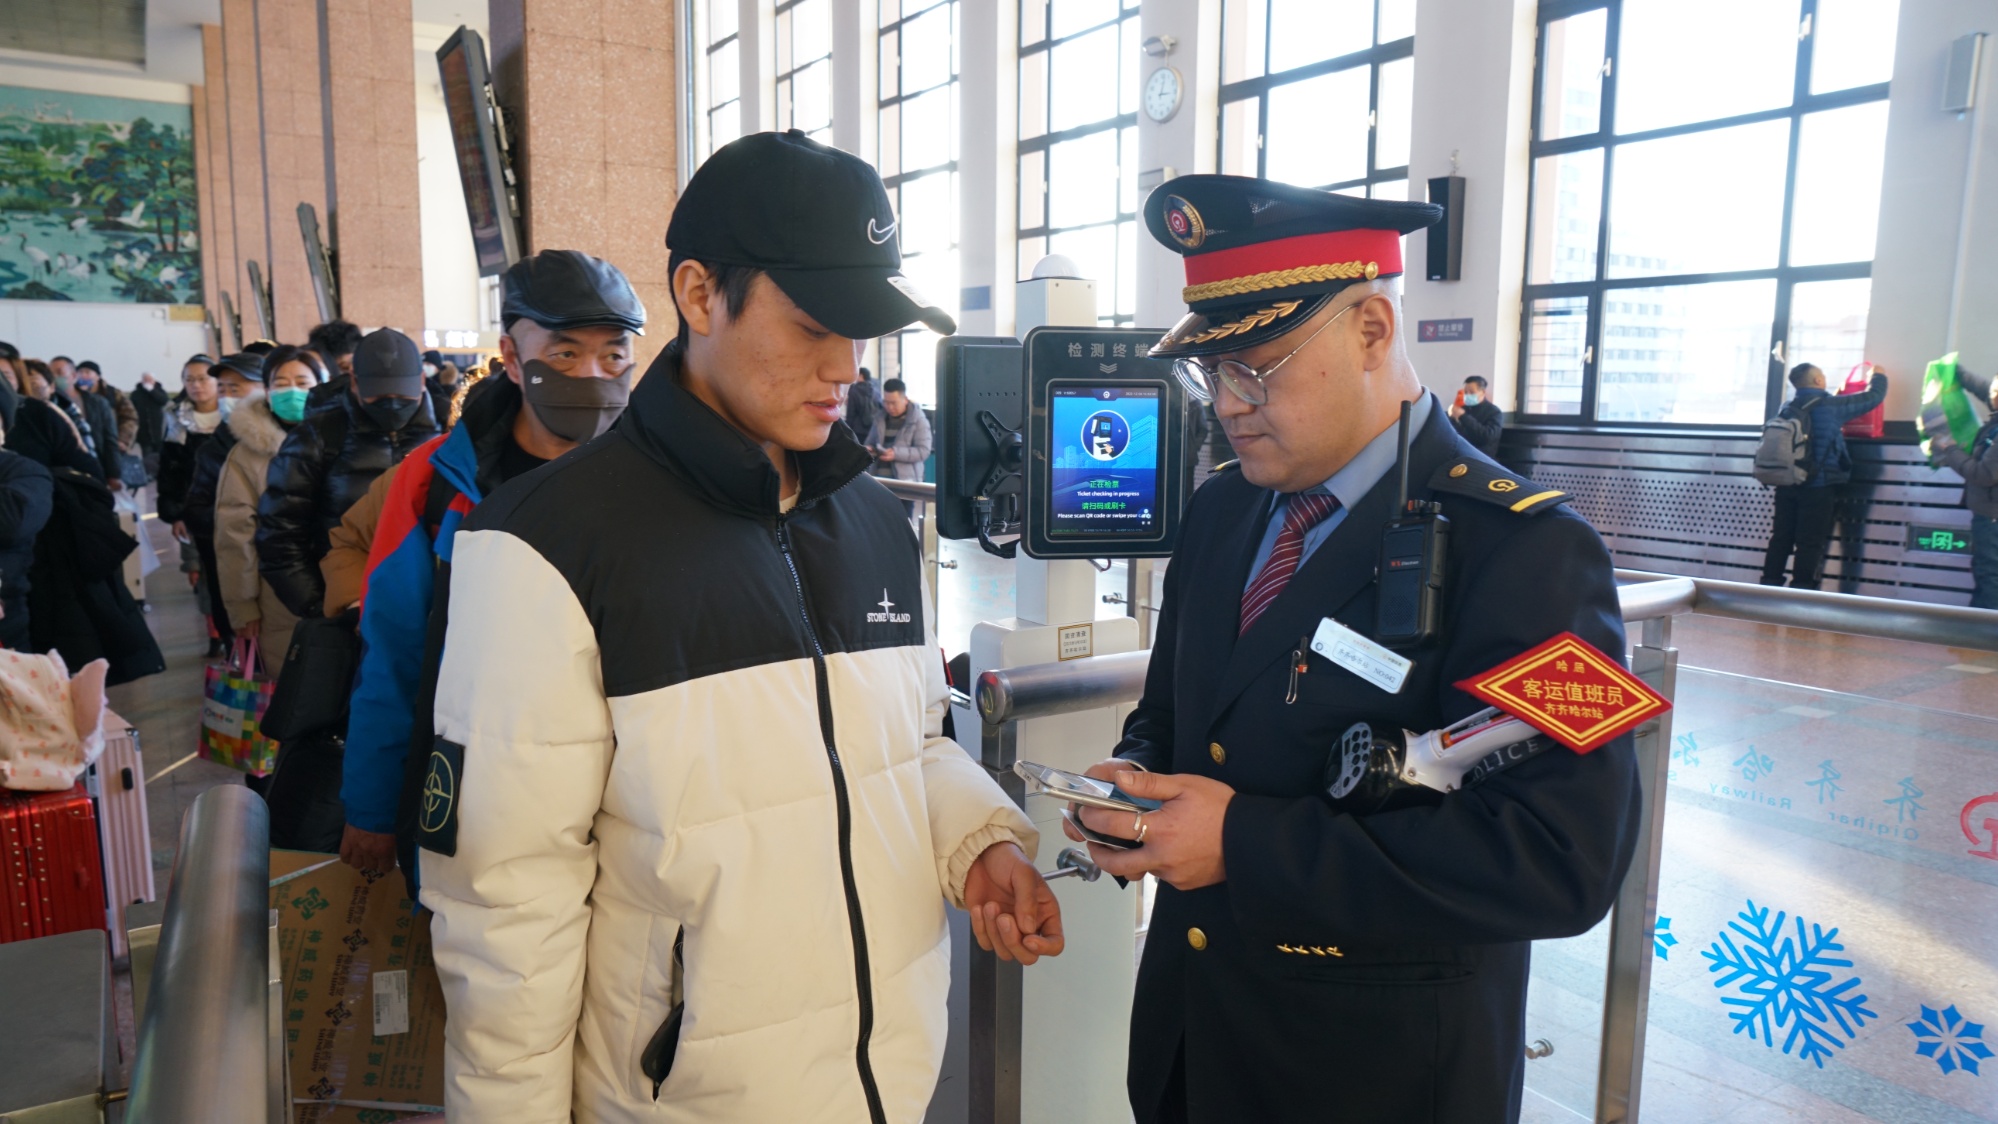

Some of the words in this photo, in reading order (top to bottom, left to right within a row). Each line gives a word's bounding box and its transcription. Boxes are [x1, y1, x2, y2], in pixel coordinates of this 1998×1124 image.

[1068, 342, 1149, 358] 检测终端
[1089, 480, 1119, 489] 正在检票
[1082, 502, 1126, 510] 请扫码或刷卡
[867, 612, 887, 622] STONE
[889, 612, 910, 623] ISLAND
[1522, 677, 1625, 707] 客运值班员
[1544, 702, 1604, 719] 齐齐哈尔站
[1473, 740, 1538, 781] OLICE
